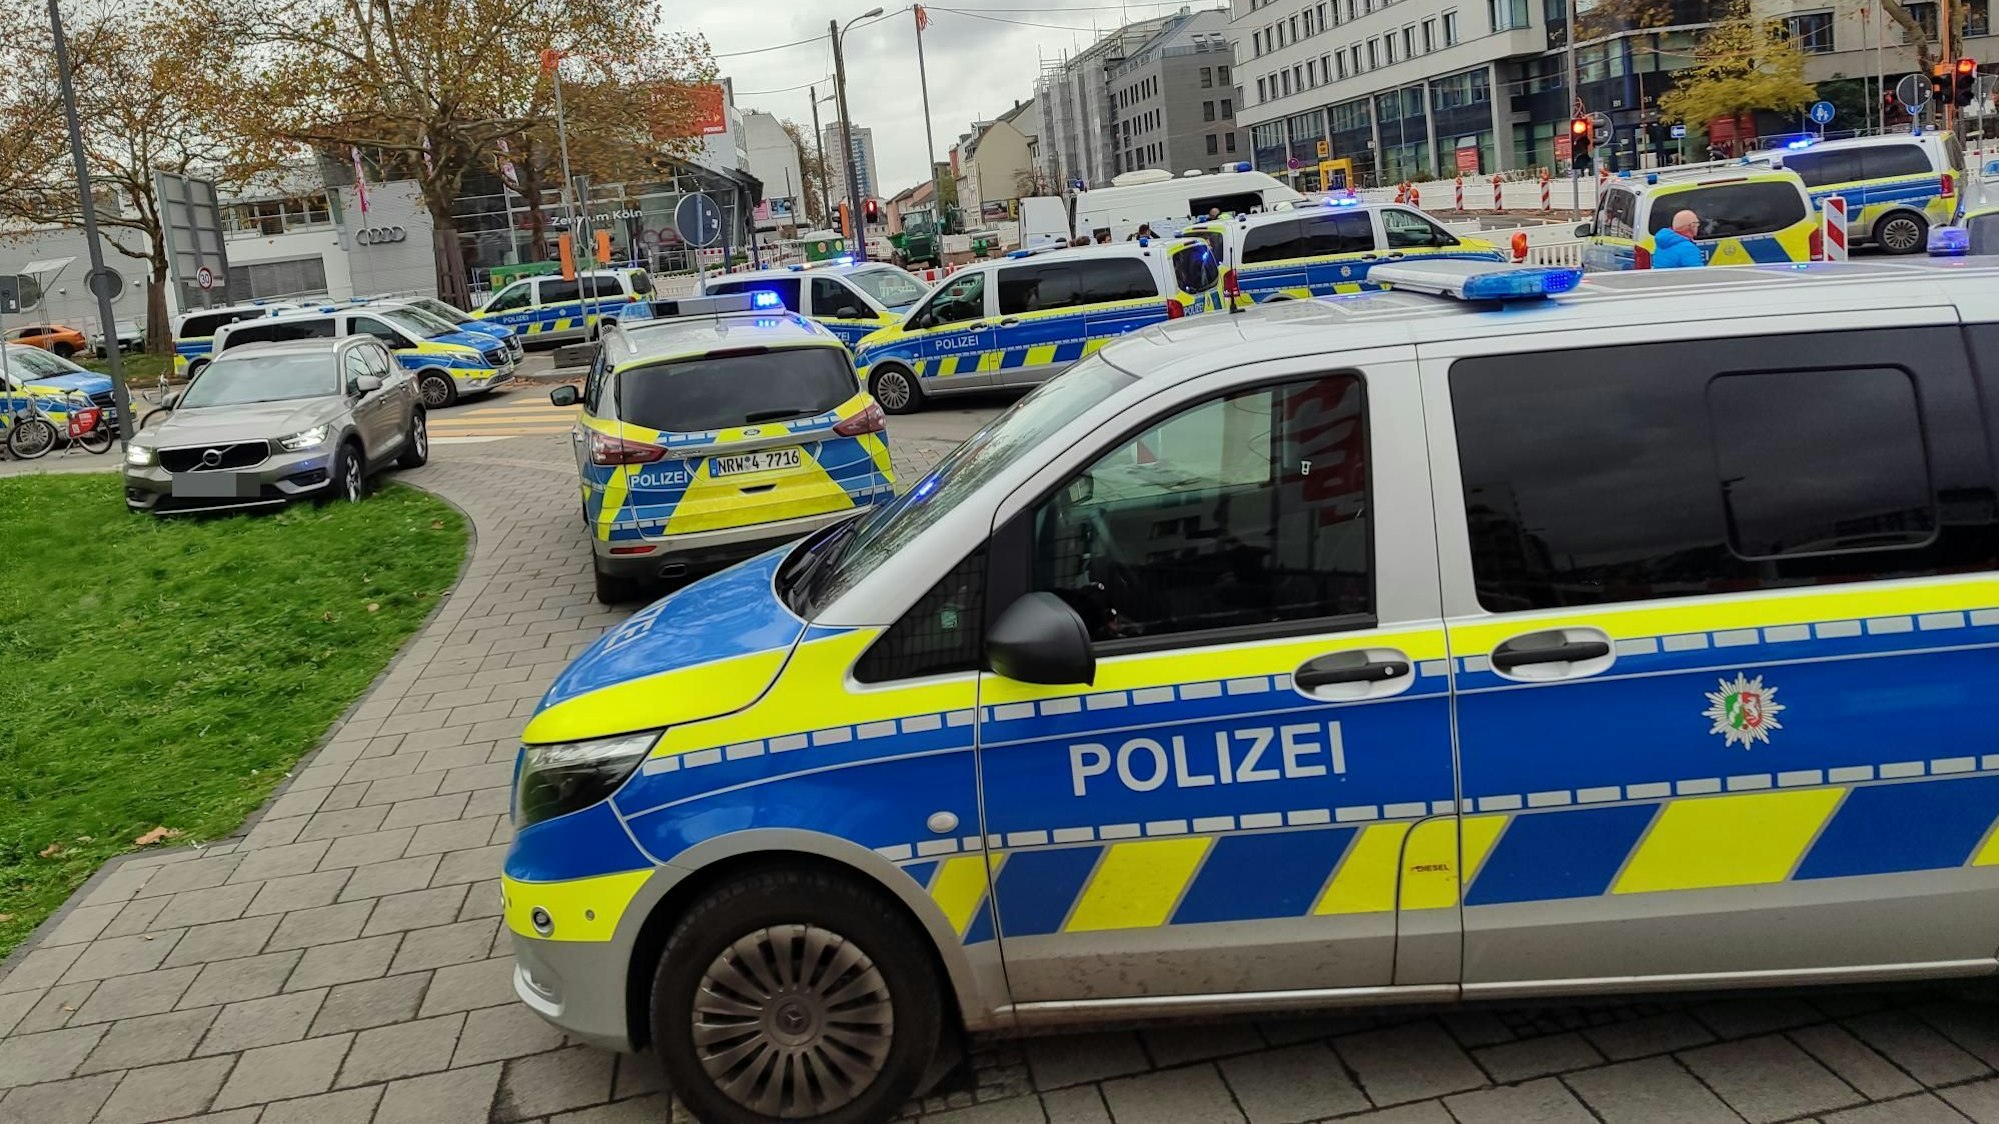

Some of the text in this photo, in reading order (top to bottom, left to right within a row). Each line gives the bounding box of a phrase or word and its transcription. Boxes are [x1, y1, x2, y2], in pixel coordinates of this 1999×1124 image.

[613, 209, 642, 219] Köln
[201, 274, 209, 284] 30
[503, 315, 529, 324] POLIZEI
[935, 335, 979, 350] POLIZEI
[717, 458, 745, 474] NRW
[631, 471, 688, 488] POLIZEI
[1069, 721, 1346, 796] POLIZEI
